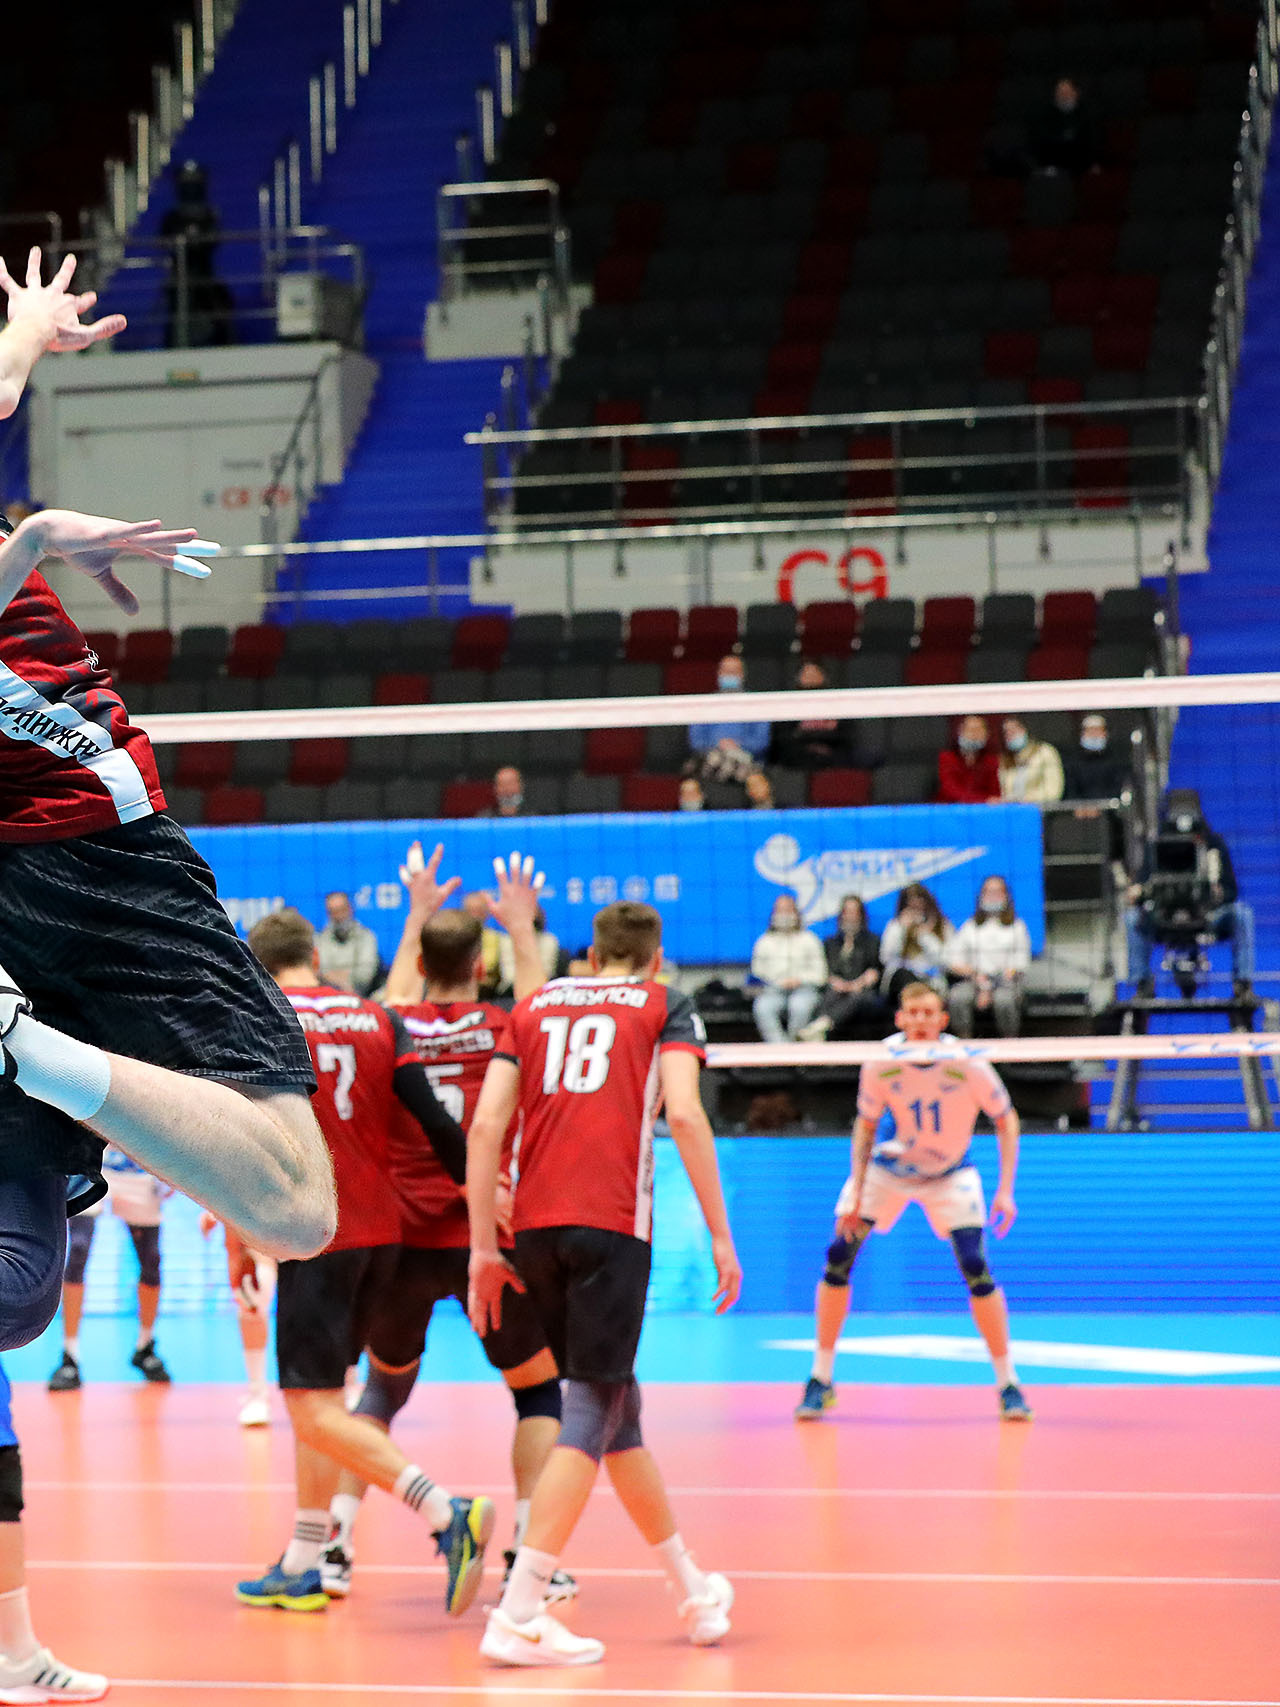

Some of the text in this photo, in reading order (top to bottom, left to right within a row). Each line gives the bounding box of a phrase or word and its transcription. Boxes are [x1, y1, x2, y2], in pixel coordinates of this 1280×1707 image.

[777, 547, 888, 602] C9
[316, 1043, 357, 1120] 7
[540, 1014, 617, 1095] 18
[425, 1064, 464, 1122] 5
[909, 1099, 940, 1133] 11
